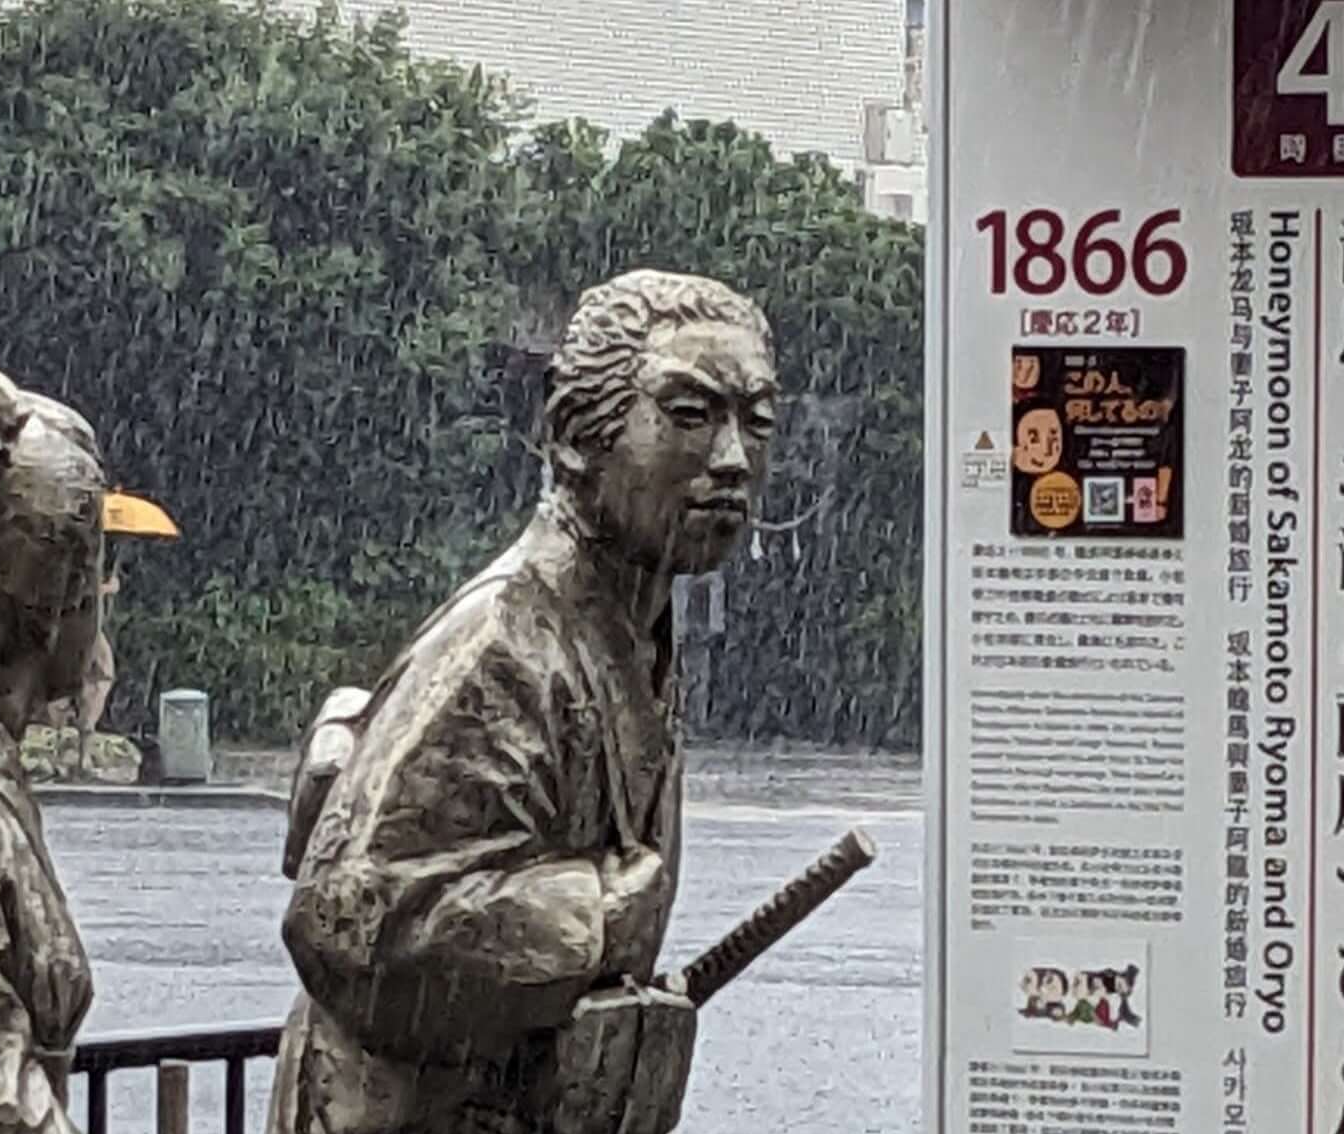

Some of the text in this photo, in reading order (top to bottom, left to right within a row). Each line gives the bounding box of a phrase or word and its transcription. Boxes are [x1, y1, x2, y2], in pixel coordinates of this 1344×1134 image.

[975, 208, 1188, 296] 1866
[1254, 210, 1300, 1034] Honeymoon of Sakamoto Ryoma and Oryo
